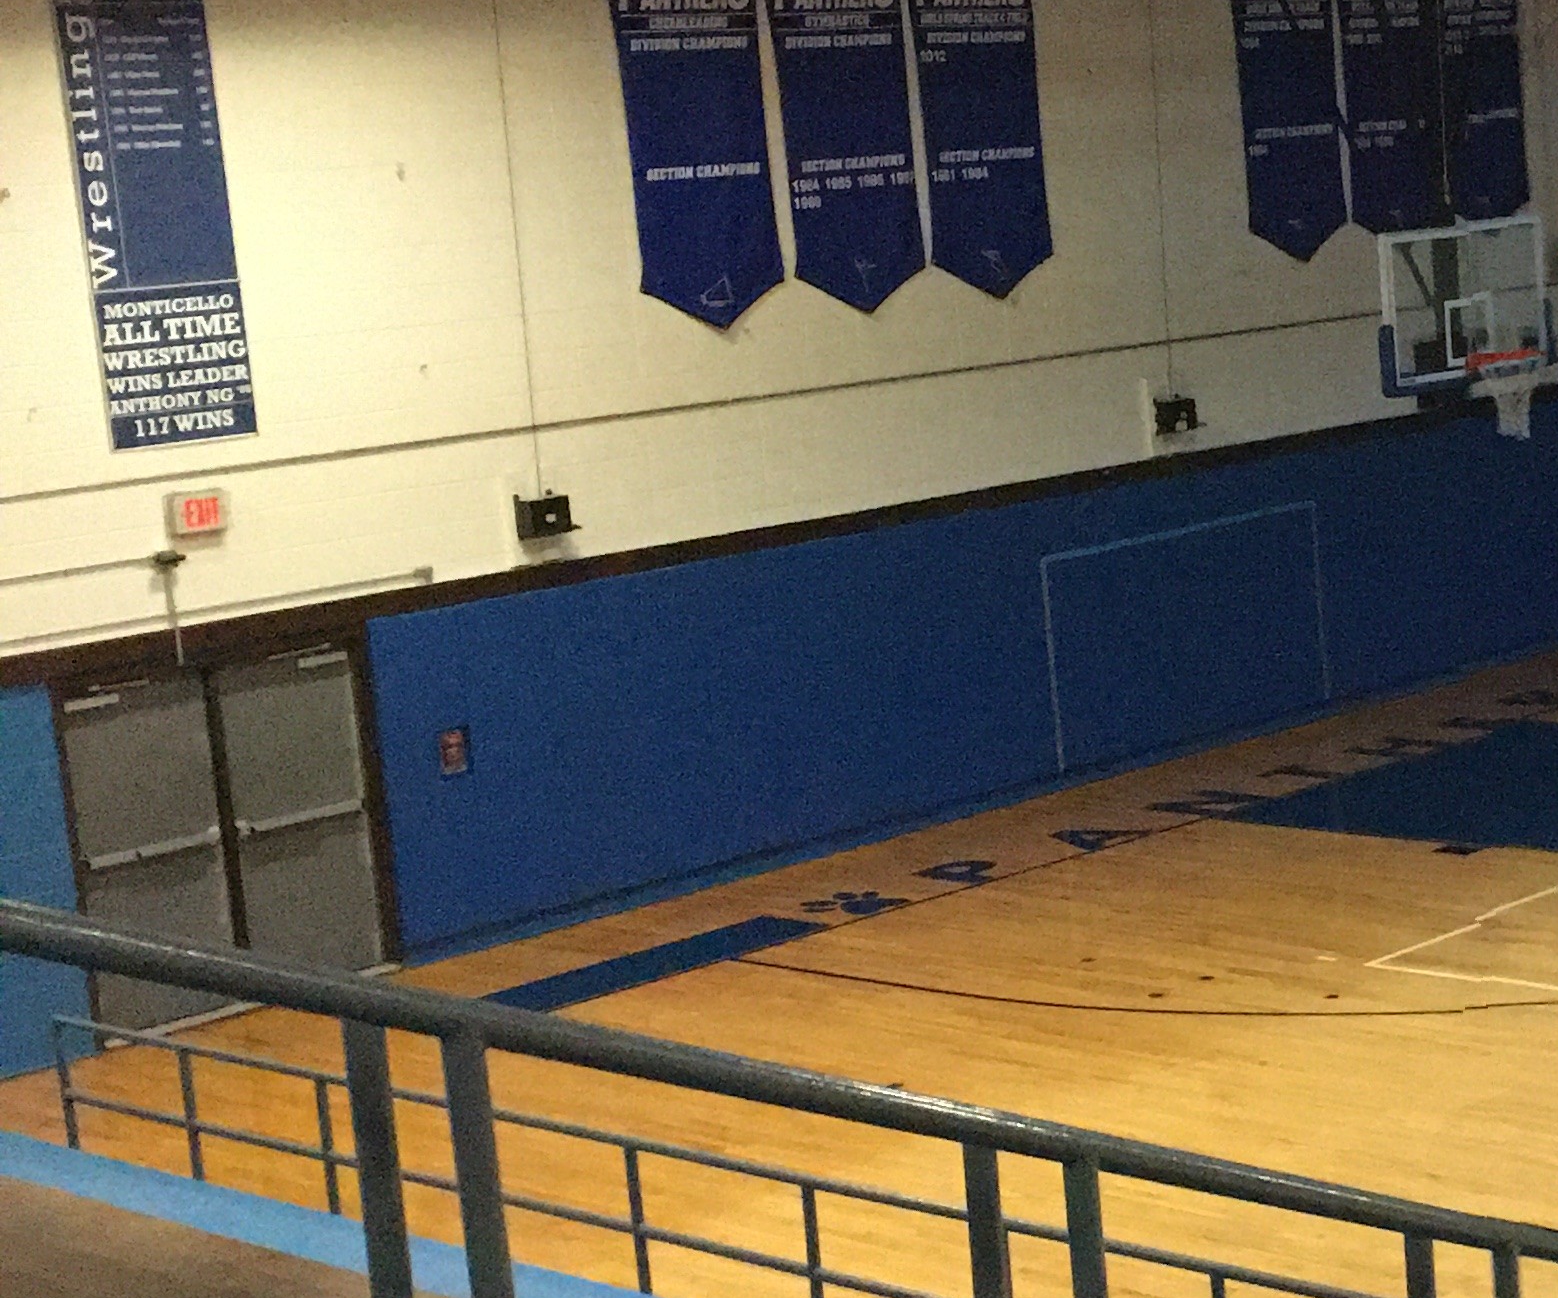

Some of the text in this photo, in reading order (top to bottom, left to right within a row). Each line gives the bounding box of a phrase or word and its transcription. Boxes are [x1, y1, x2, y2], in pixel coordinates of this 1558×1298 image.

[65, 12, 118, 289] Wrestling
[646, 161, 761, 182] SECTION CHAMPIONS
[103, 294, 234, 320] MONTICELLO
[103, 312, 242, 347] ALL TIME
[104, 339, 246, 372] WRESTLING
[107, 364, 249, 394] WINS LEADER
[110, 390, 203, 415] ANTHONY
[206, 387, 234, 404] NG
[135, 409, 235, 438] 117 WINS
[184, 497, 218, 528] EXIT
